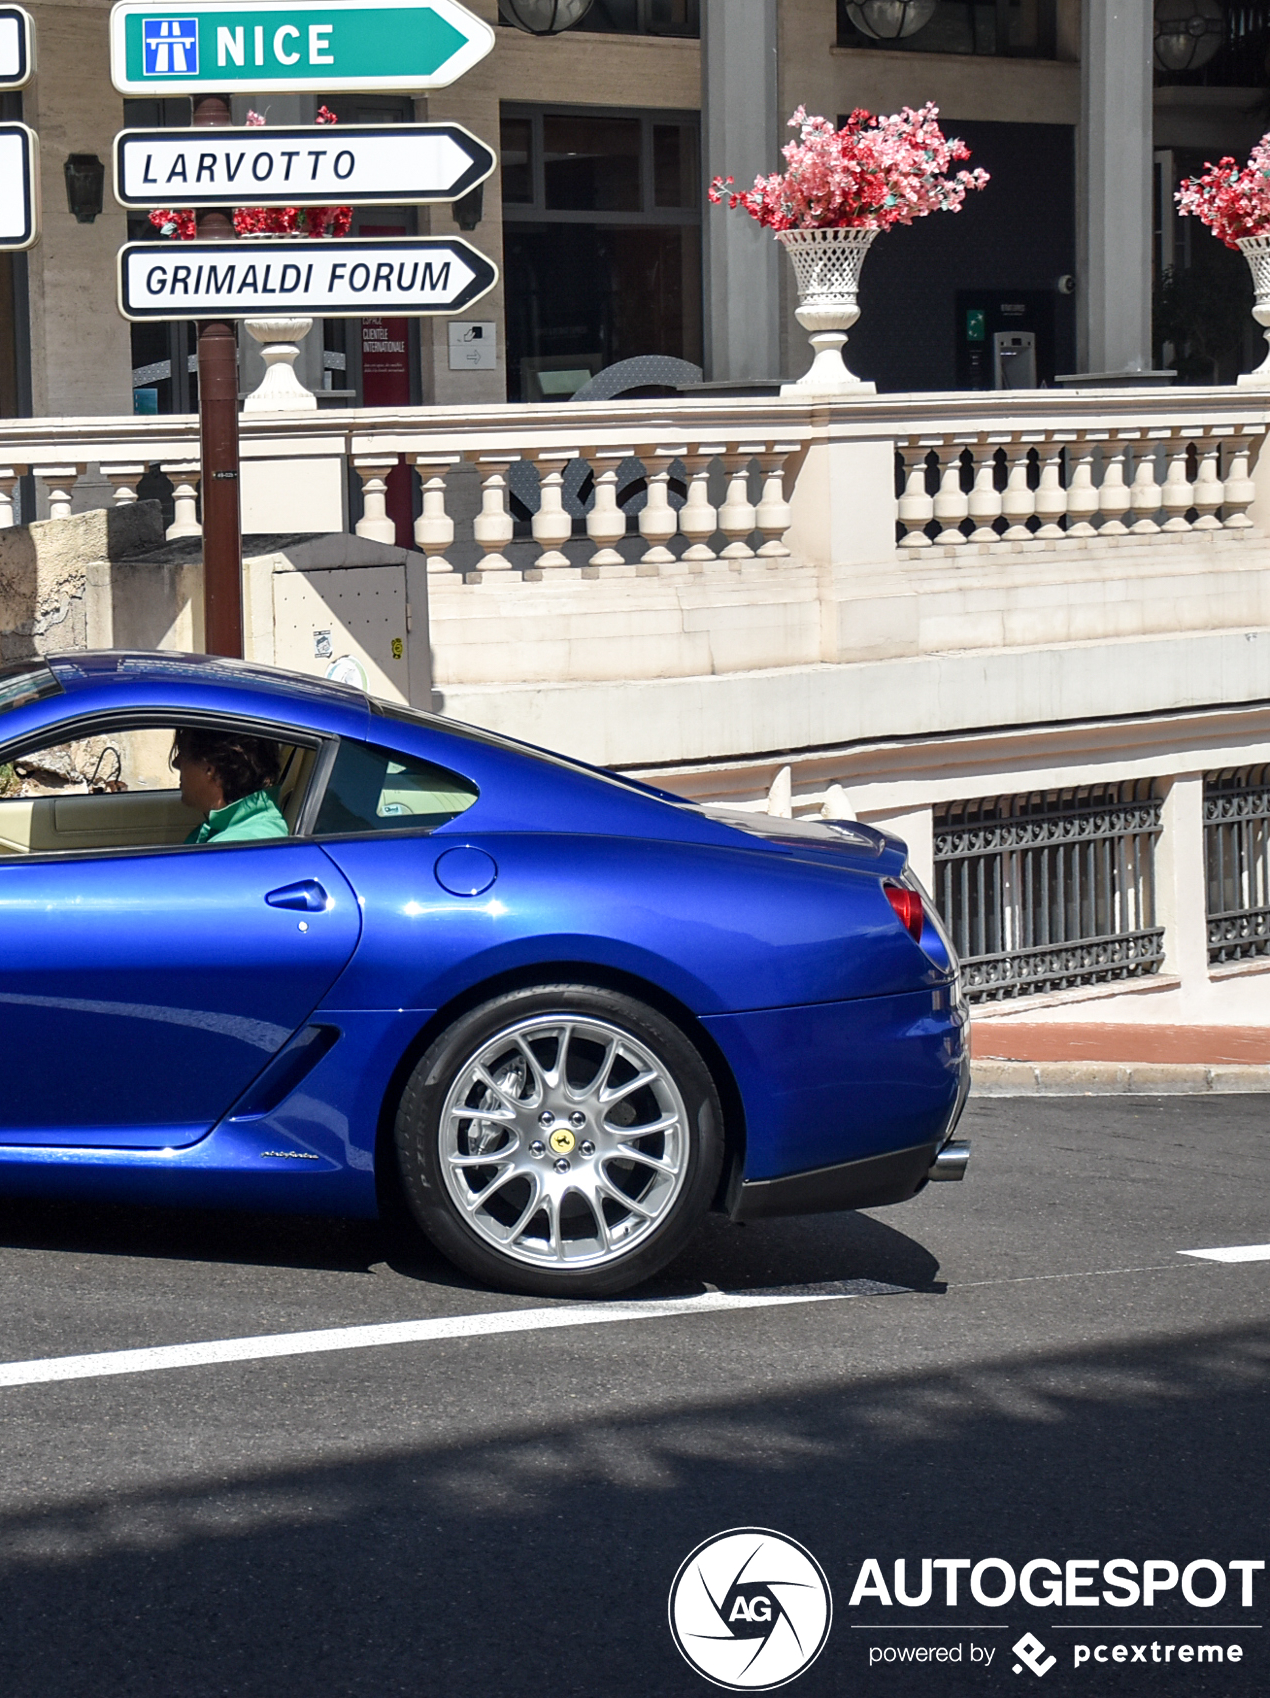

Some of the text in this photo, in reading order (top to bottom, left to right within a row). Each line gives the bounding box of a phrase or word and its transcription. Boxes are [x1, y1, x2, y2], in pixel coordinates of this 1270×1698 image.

[216, 23, 335, 67] NICE
[142, 150, 356, 184] LARVOTTO
[145, 261, 452, 295] GRIMALDI FORUM
[364, 341, 405, 352] INTERNATIONALE
